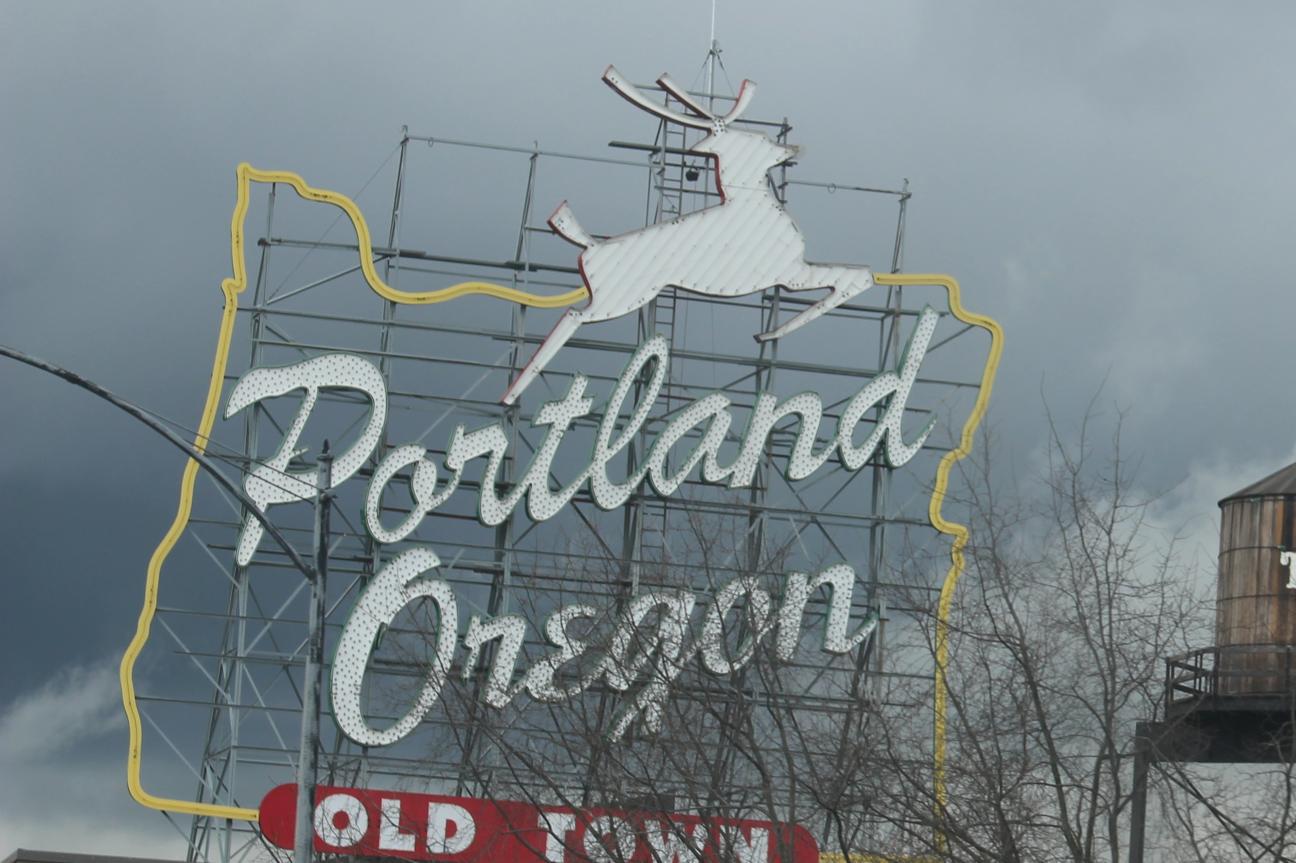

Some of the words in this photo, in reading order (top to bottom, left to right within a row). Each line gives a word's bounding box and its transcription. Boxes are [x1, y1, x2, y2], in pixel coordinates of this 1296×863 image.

[224, 304, 938, 567] Portland
[331, 547, 878, 747] Oregon
[314, 793, 476, 855] OLD
[537, 812, 769, 863] TOWN
